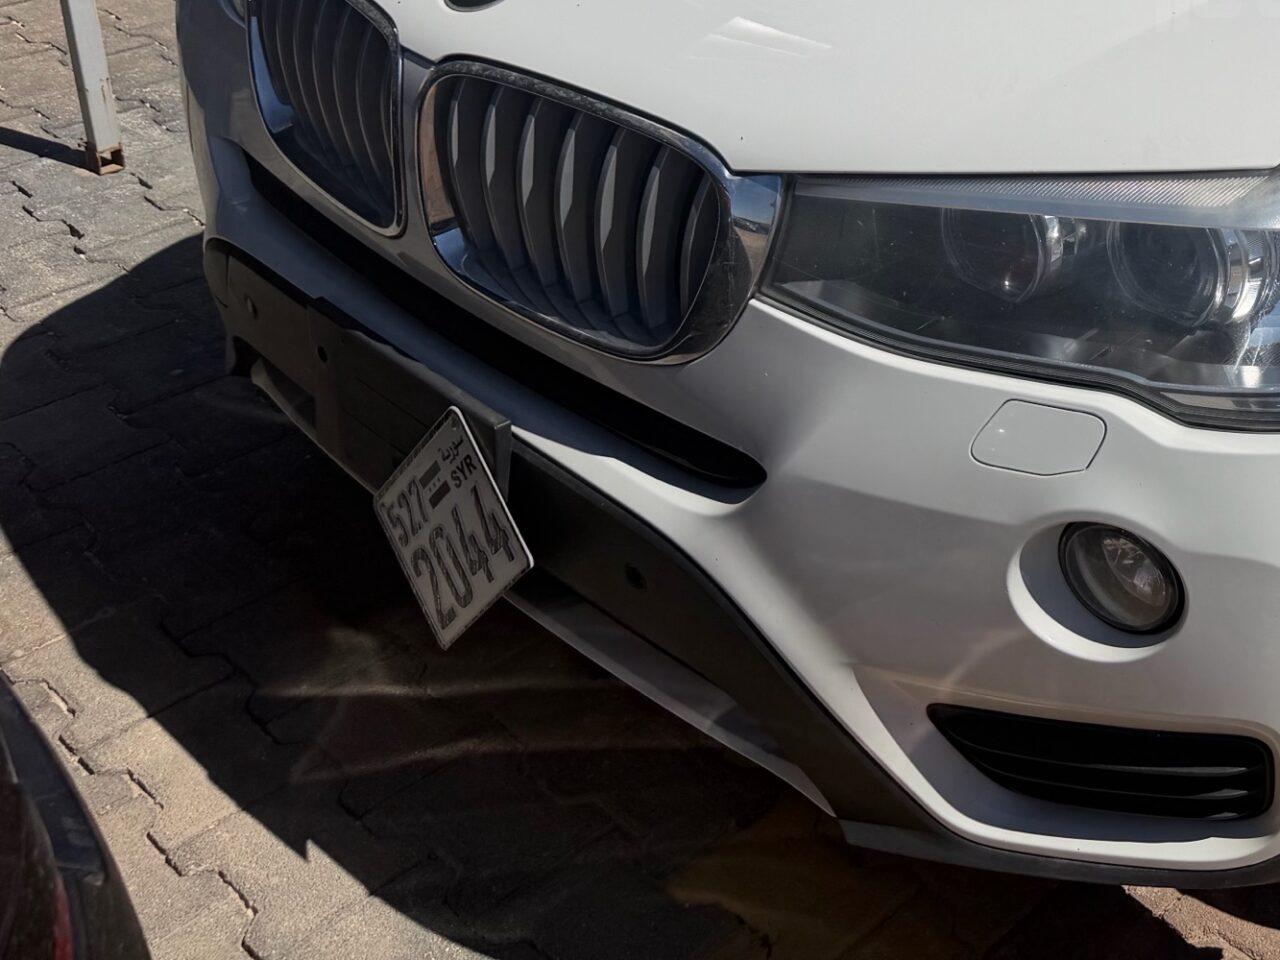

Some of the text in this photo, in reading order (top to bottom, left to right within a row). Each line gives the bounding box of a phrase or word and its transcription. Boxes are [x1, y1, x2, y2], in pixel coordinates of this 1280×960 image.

[450, 453, 478, 490] SYR
[386, 476, 429, 548] 527
[410, 482, 515, 631] 2044
